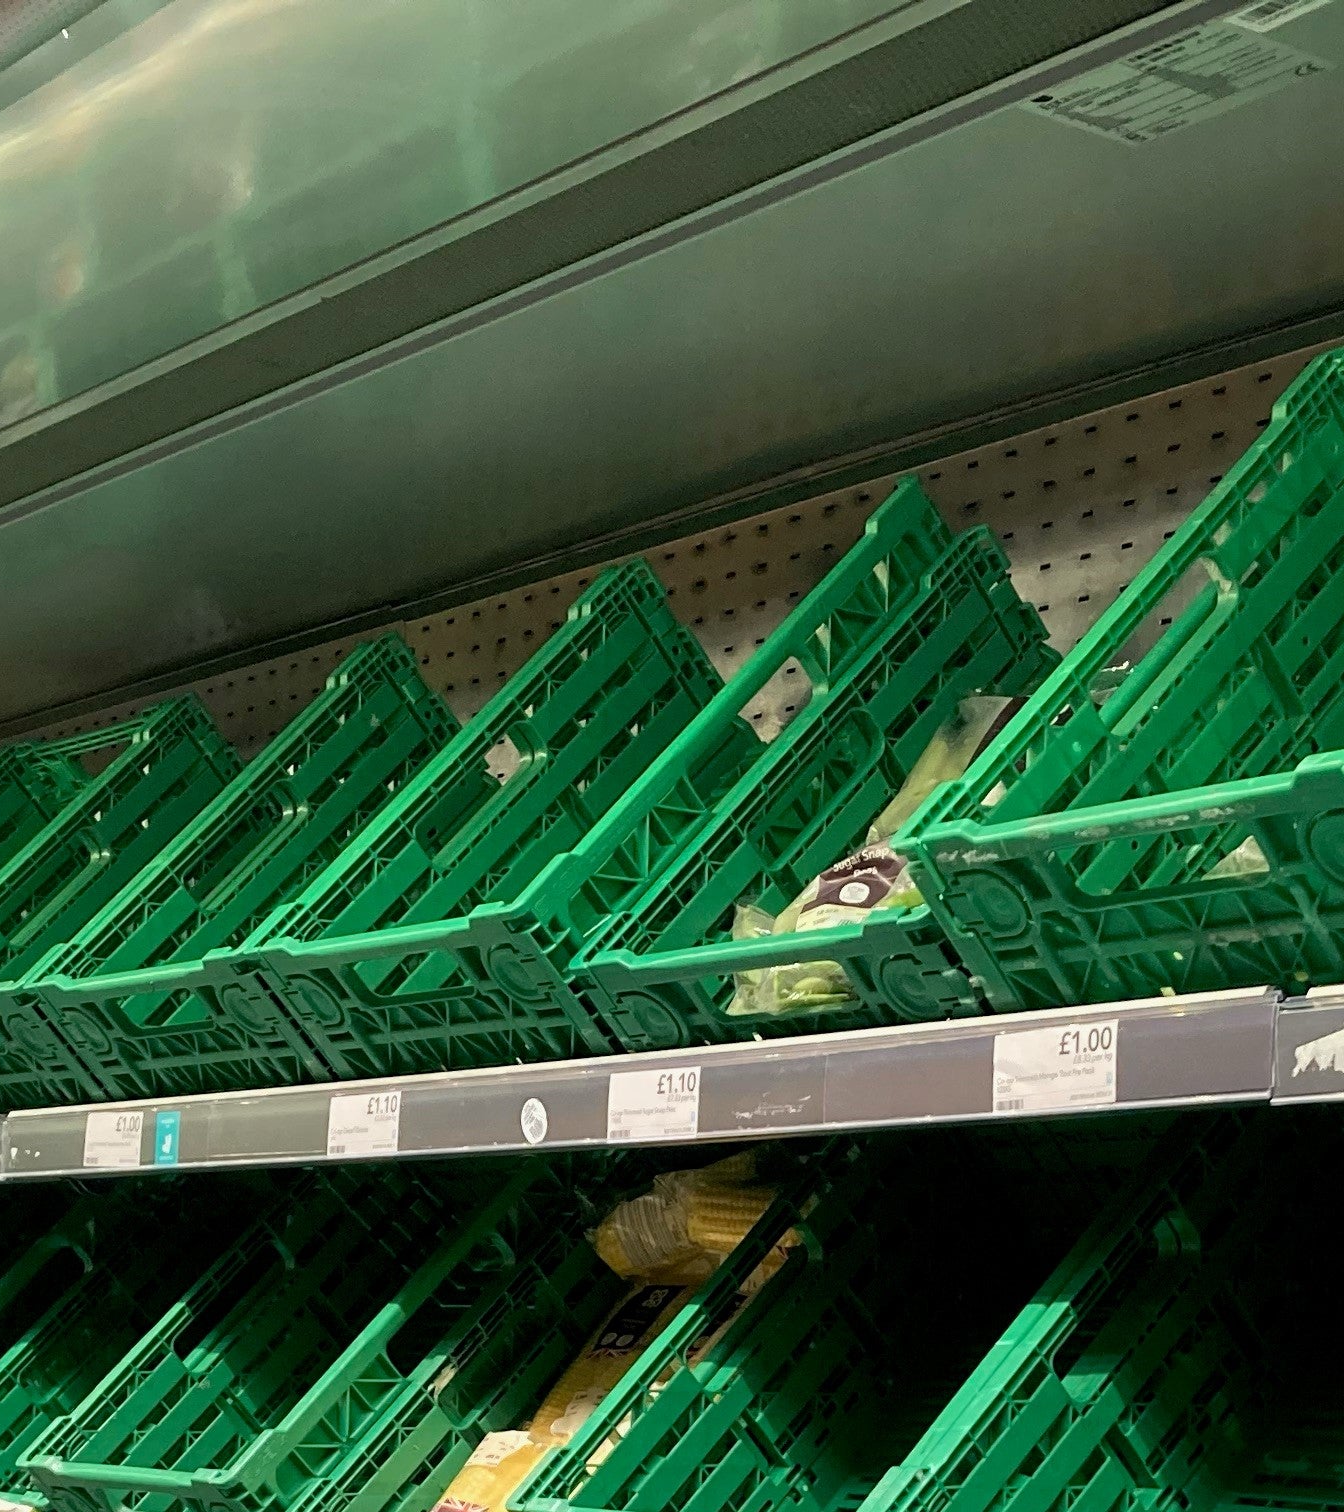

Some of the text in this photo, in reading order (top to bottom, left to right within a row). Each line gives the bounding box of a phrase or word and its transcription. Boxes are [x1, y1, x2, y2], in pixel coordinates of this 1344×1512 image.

[861, 846, 890, 862] Snap
[1059, 1026, 1112, 1055] £1.00
[657, 1071, 697, 1095] £1.10
[367, 1094, 398, 1115] £1.10
